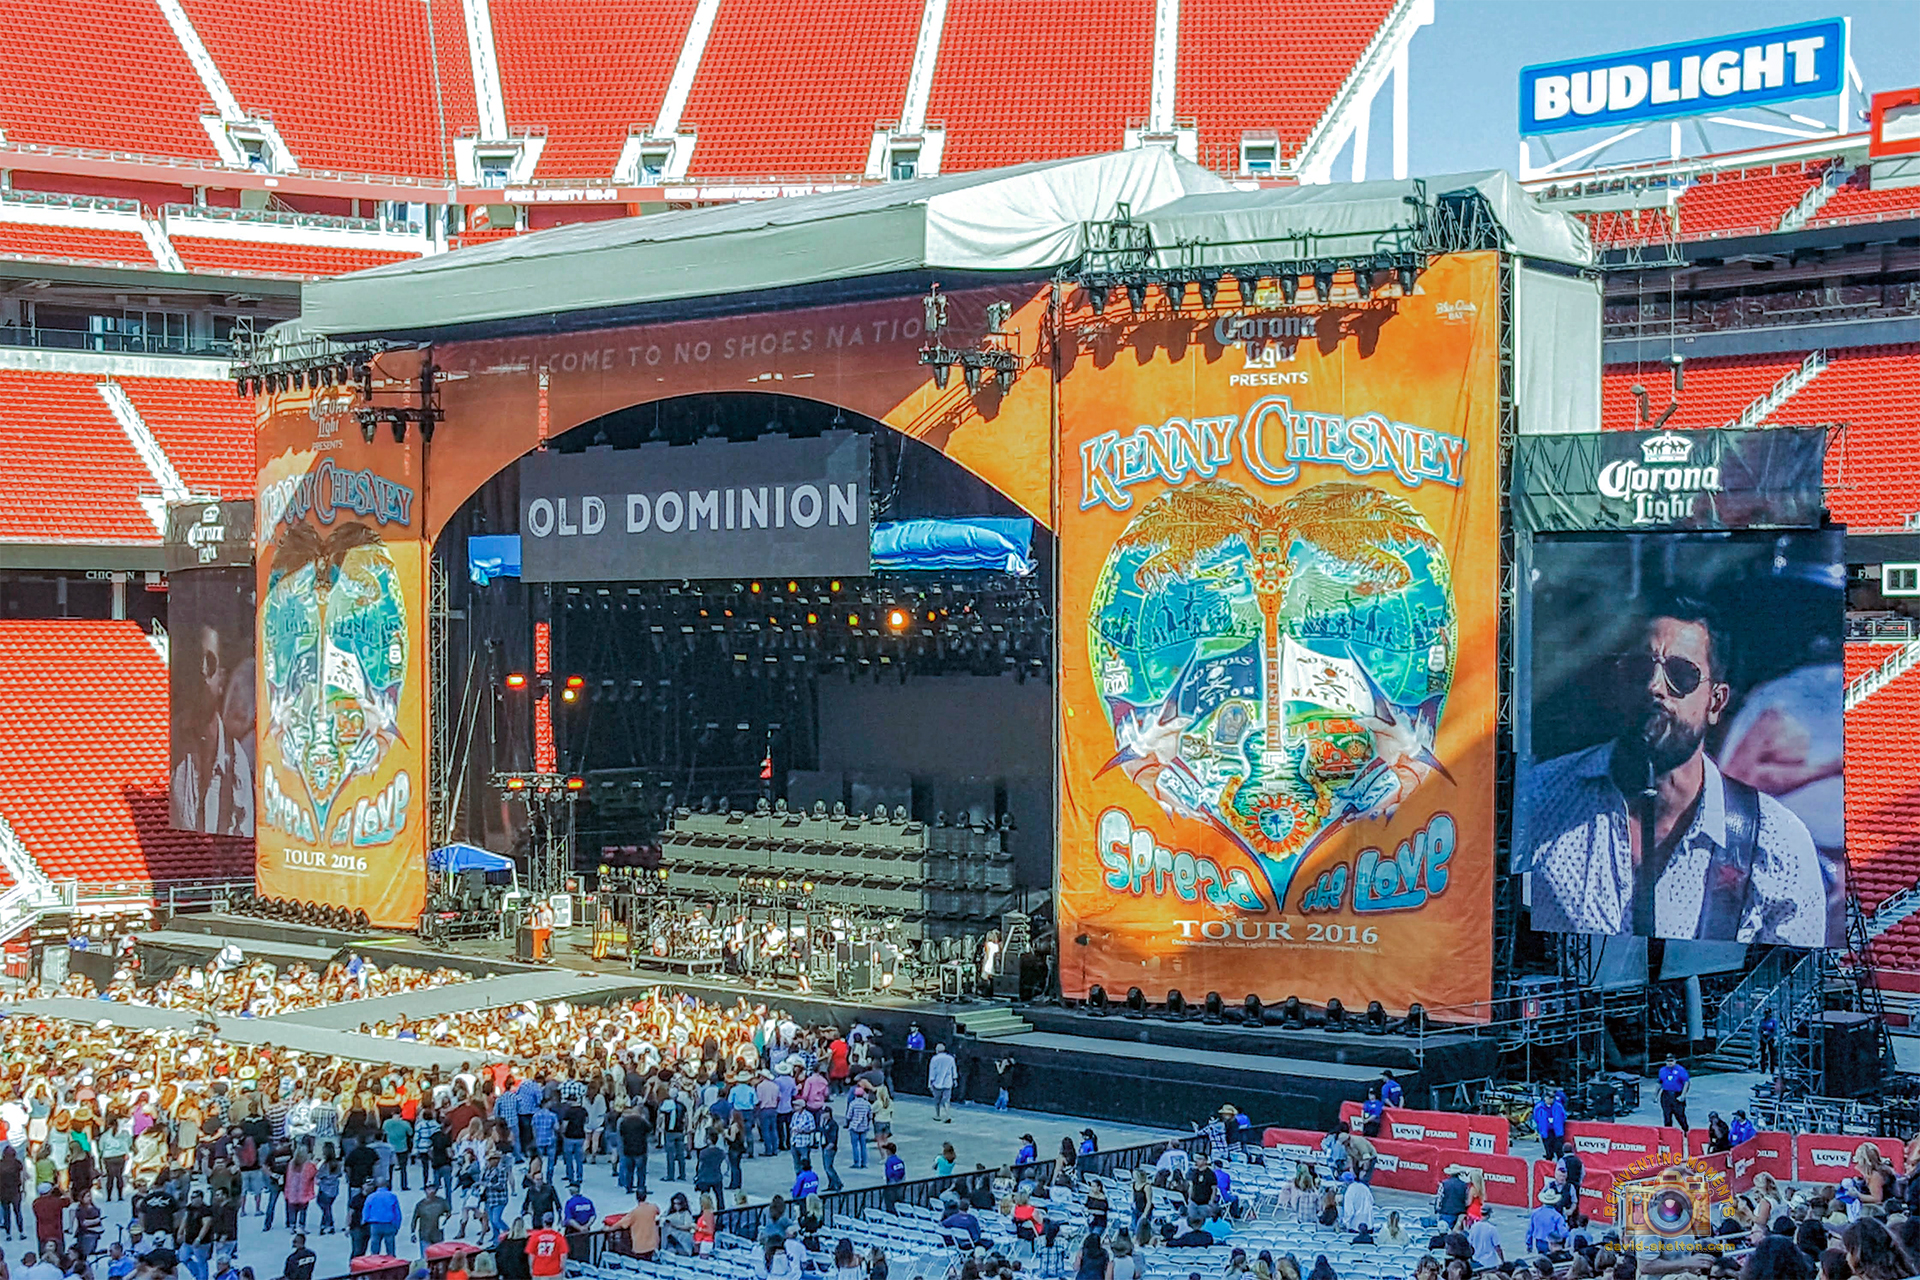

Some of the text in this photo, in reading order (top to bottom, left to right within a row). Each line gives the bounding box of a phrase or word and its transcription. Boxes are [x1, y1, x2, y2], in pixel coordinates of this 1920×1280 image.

[629, 346, 661, 366] TO
[675, 340, 711, 363] NO
[724, 331, 813, 359] SHOES
[826, 317, 921, 348] NATIO
[1230, 371, 1308, 386] PRESENTS
[1080, 394, 1468, 511] KENNY CHESNEY
[314, 457, 414, 526] CHESNEY
[1598, 460, 1723, 502] Corona
[528, 483, 858, 537] OLD DOMINION
[1632, 494, 1694, 524] Light
[283, 849, 367, 871] TOUR 2016
[1173, 919, 1379, 945] TOUR 2016
[1470, 1137, 1493, 1149] EXIT
